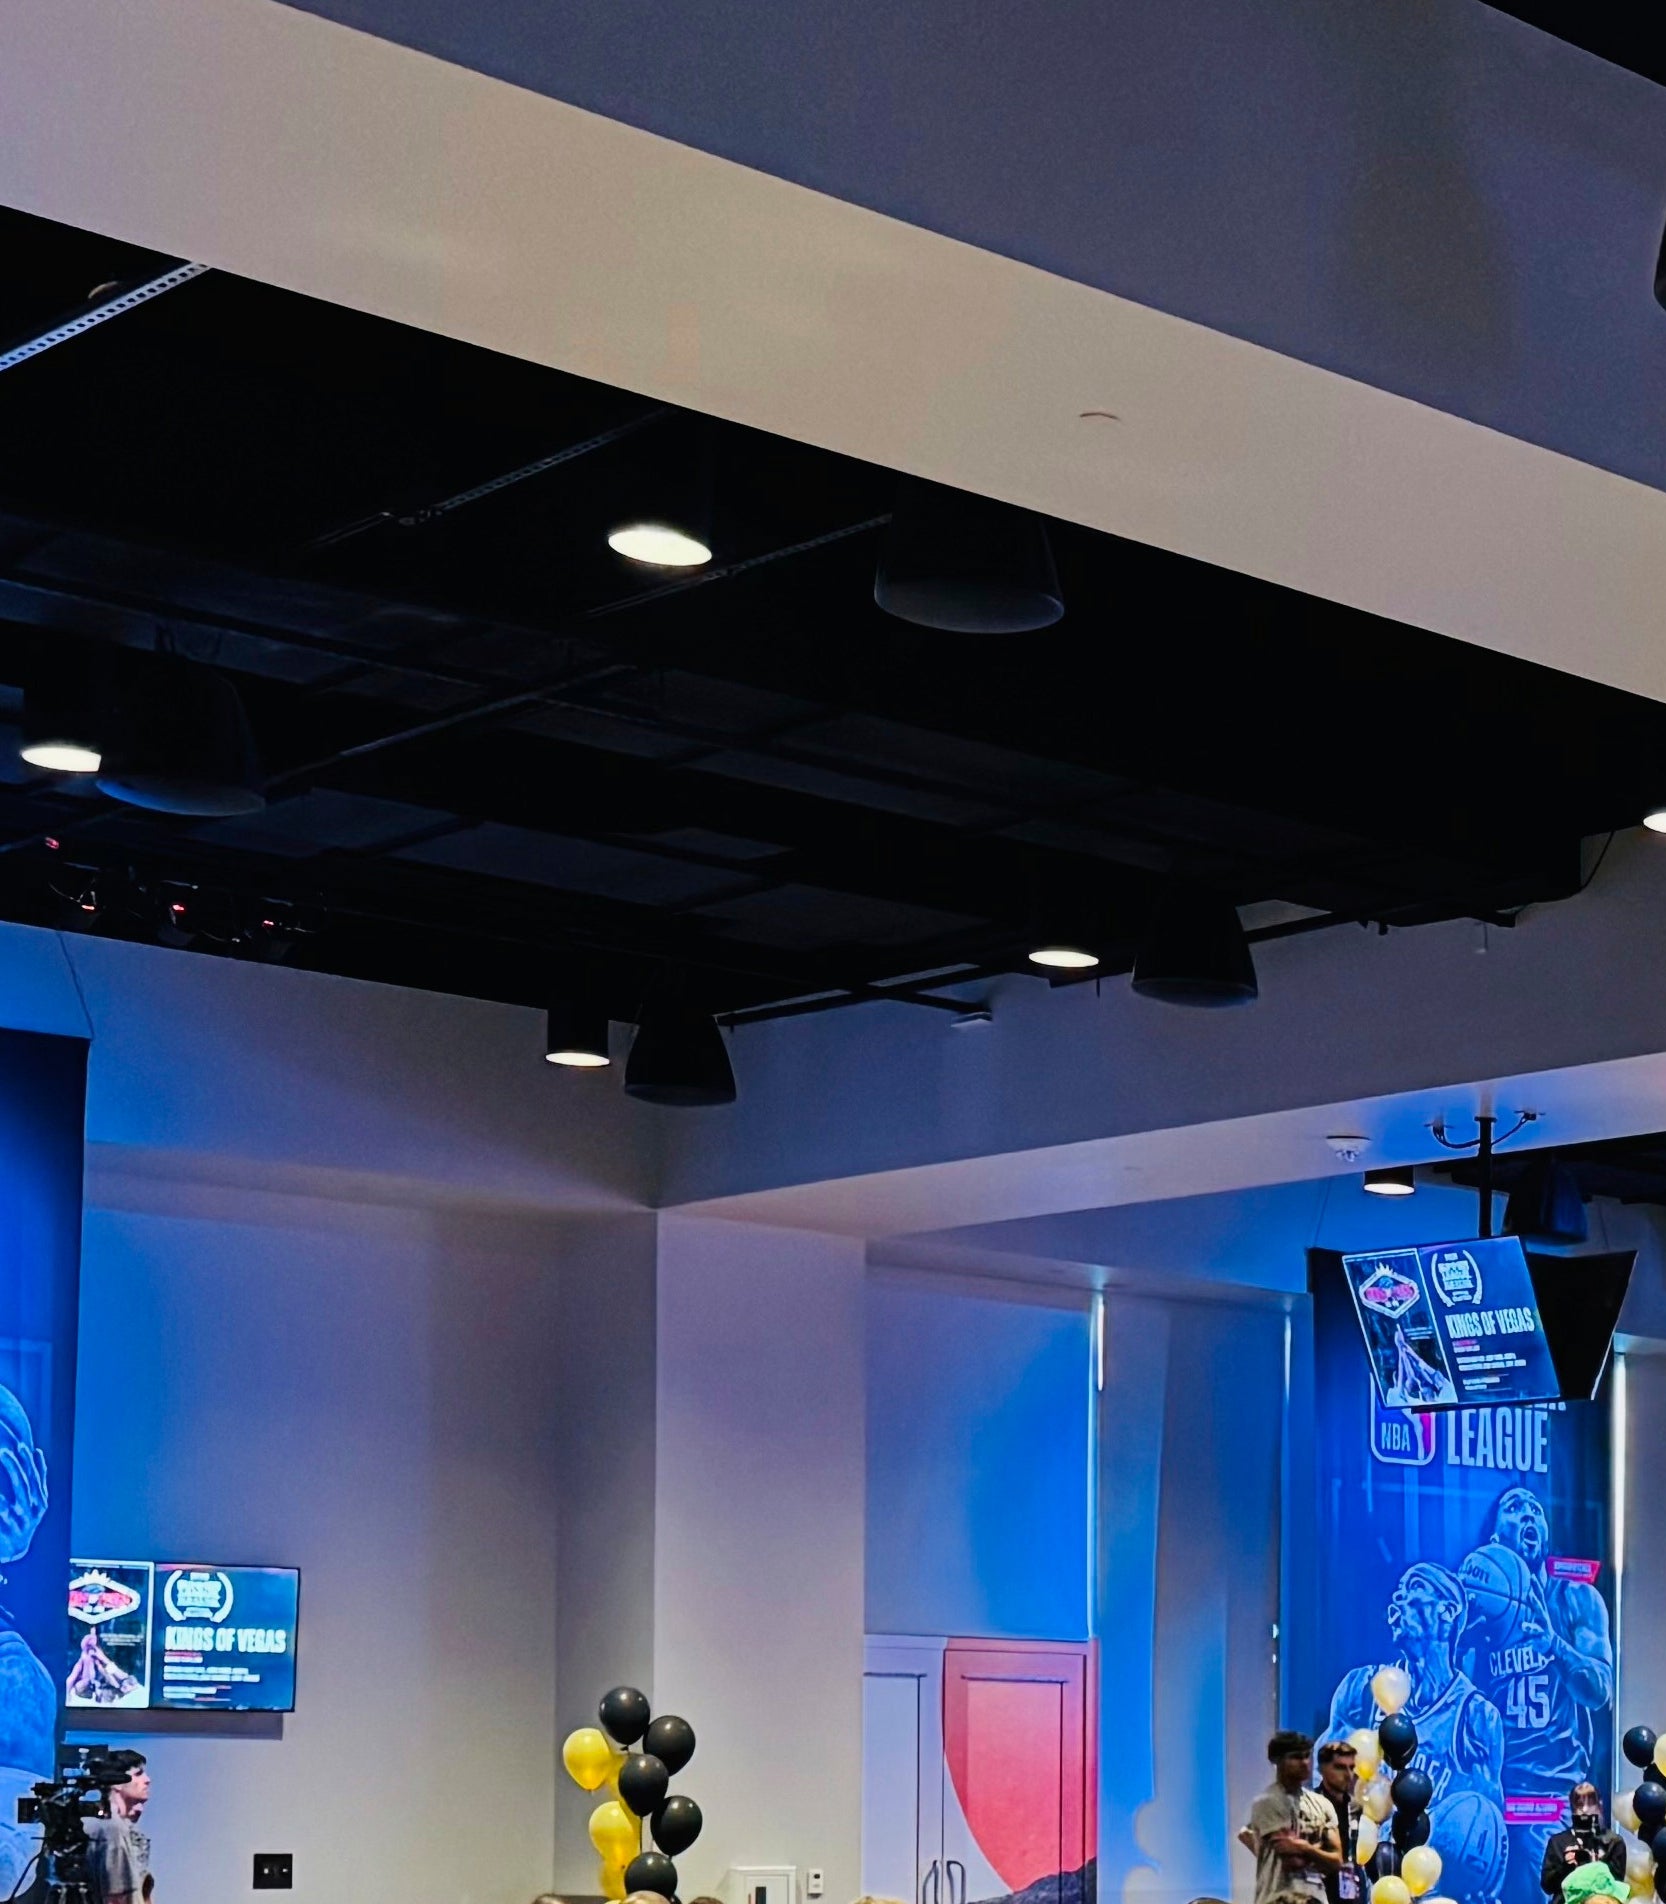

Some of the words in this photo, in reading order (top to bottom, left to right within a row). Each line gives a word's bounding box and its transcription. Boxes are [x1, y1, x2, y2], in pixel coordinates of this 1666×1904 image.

[1445, 1312, 1483, 1338] KINGS
[1481, 1309, 1497, 1335] OF
[1499, 1306, 1535, 1334] VEGAS
[1381, 1422, 1411, 1452] NBA
[1447, 1406, 1548, 1473] LEAGUE
[164, 1626, 213, 1652] KINGS
[215, 1627, 236, 1651] OF
[237, 1627, 287, 1654] VEGAS
[1506, 1674, 1551, 1729] 45
